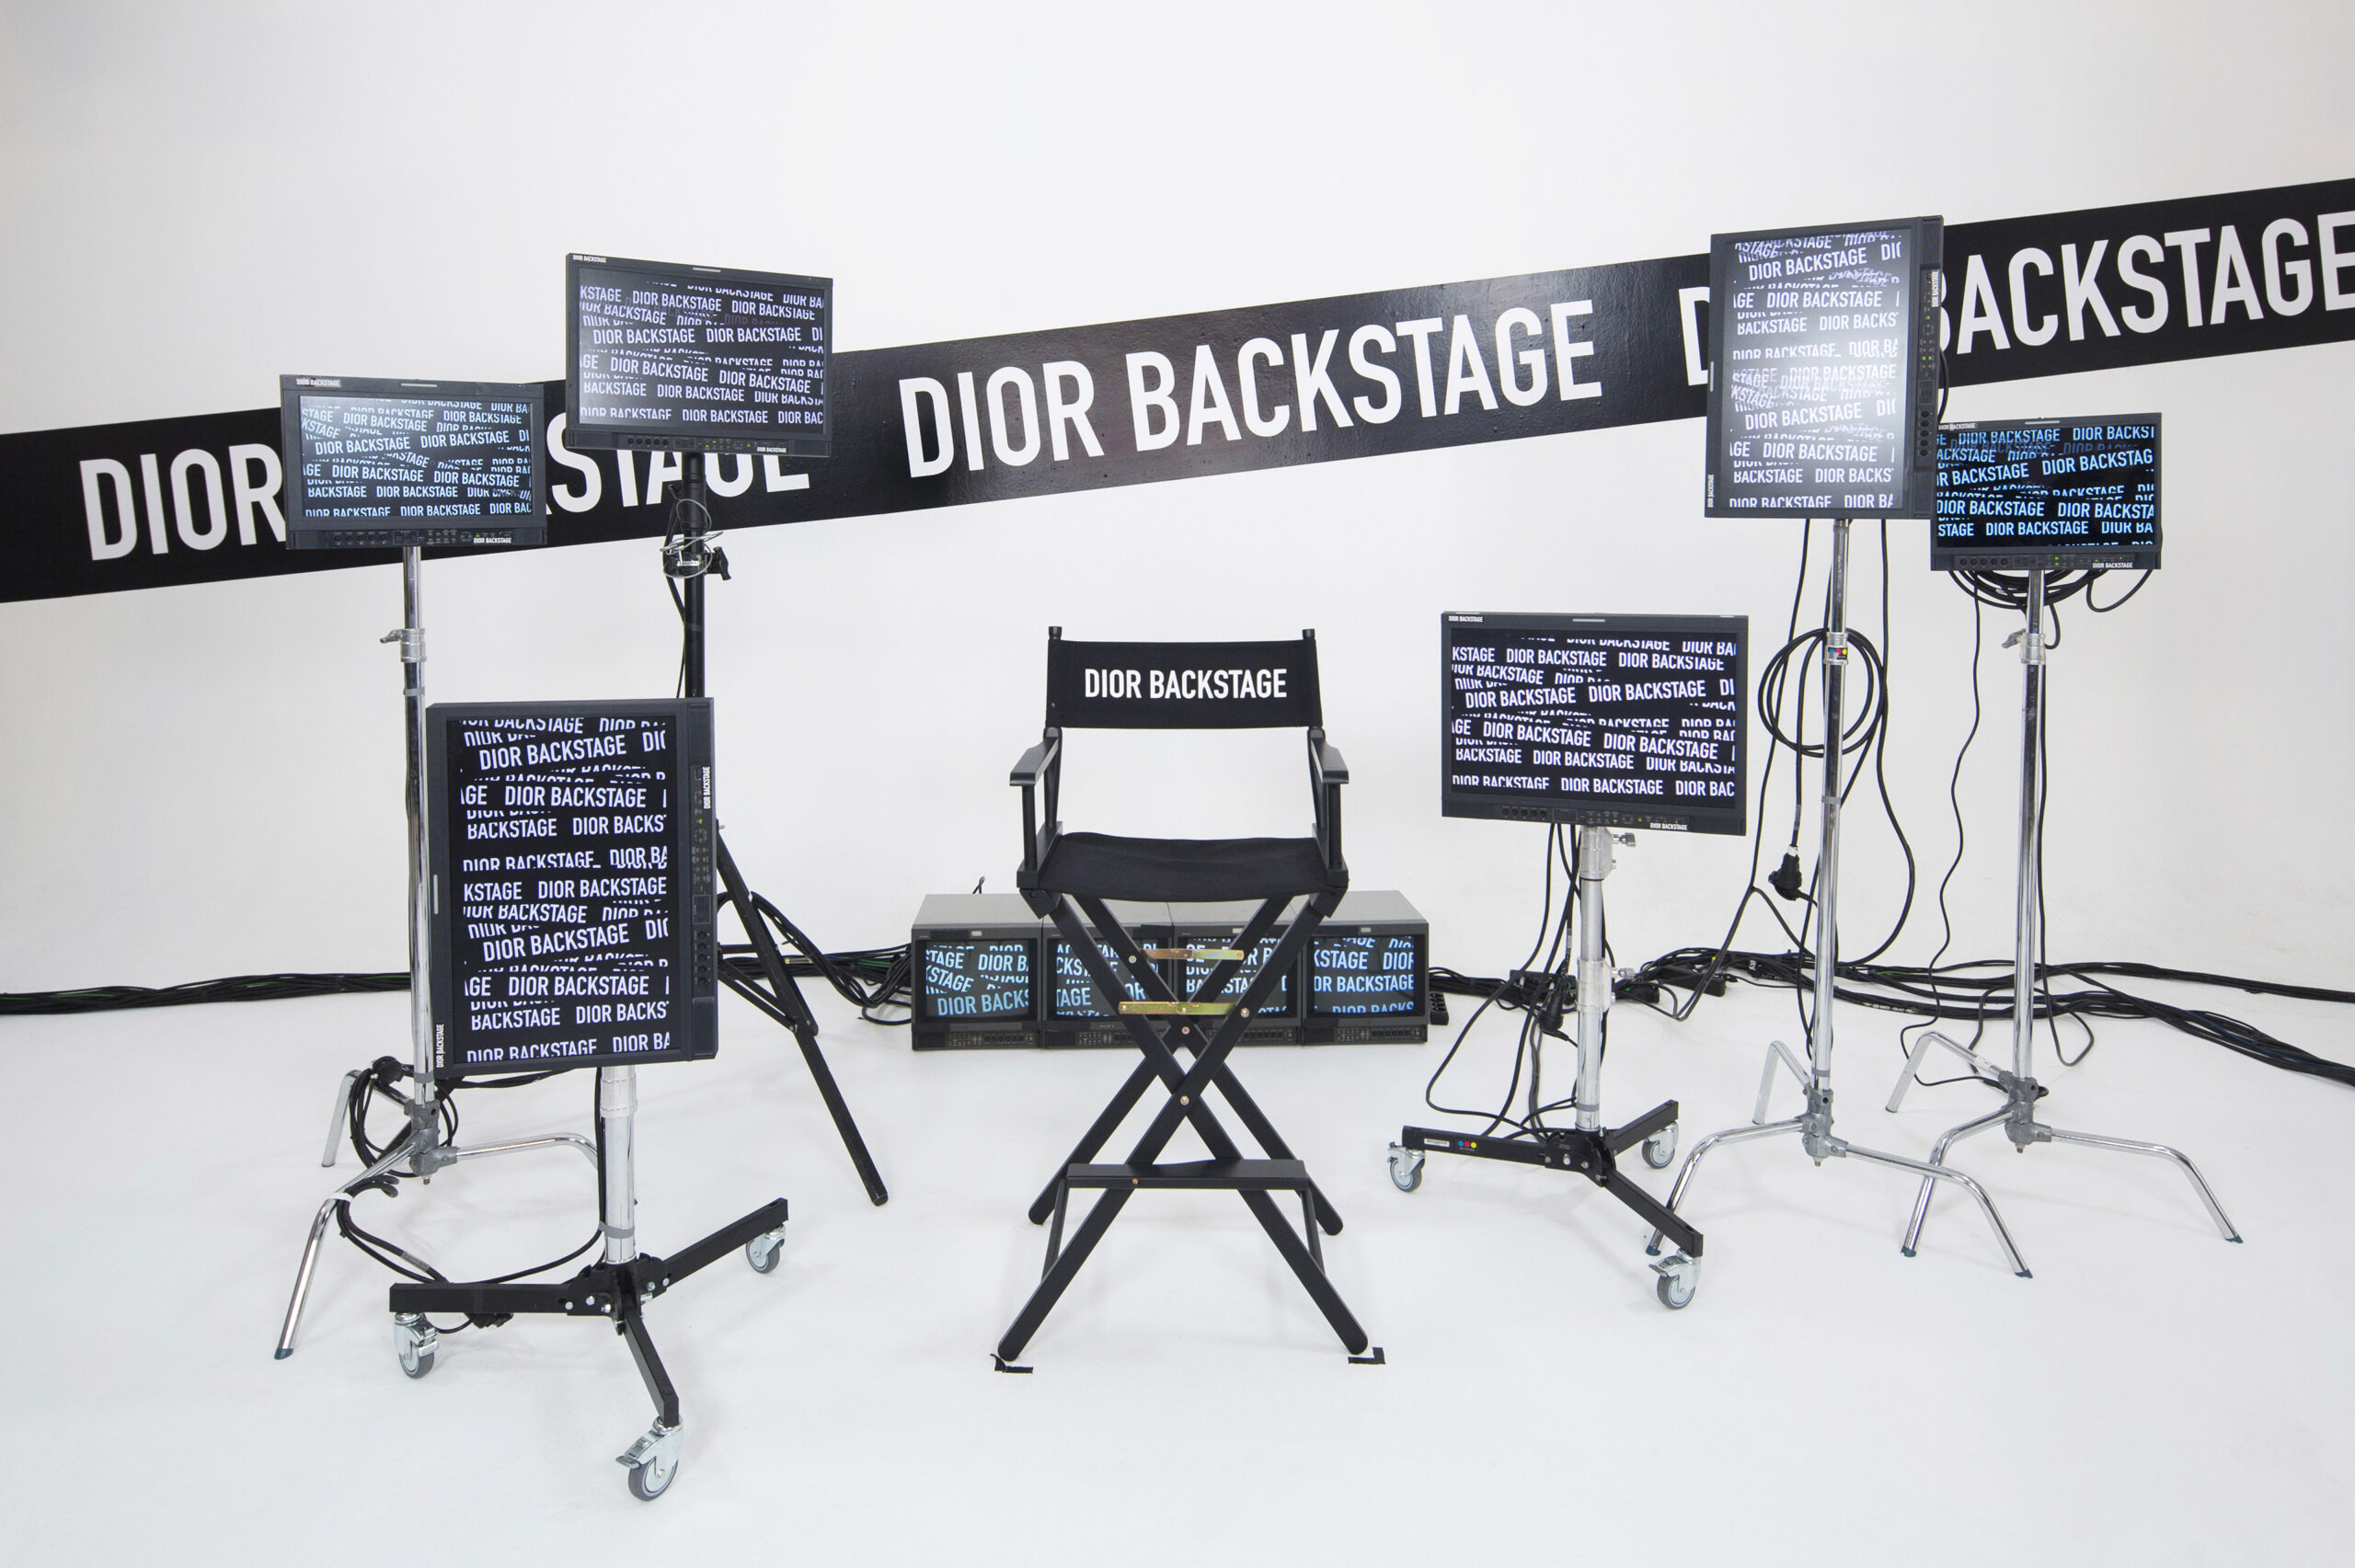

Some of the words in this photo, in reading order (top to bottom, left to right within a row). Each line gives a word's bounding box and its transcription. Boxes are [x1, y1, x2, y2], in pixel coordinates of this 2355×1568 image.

[1749, 262, 1783, 281] DIOR
[1786, 247, 1867, 276] BACKSTAGE
[632, 291, 659, 305] DIOR
[662, 293, 721, 312] BACKSTAGE
[731, 300, 756, 315] DIOR
[1766, 292, 1799, 308] DIOR
[1802, 291, 1883, 308] BACKSTAGE
[593, 329, 623, 344] DIOR
[626, 328, 695, 344] BACKSTAGE
[706, 328, 734, 343] DIOR
[738, 326, 801, 342] BACKSTAGE
[1738, 317, 1808, 335] BACKSTAGE
[1820, 315, 1849, 331] DIOR
[296, 378, 309, 386] DIOR
[311, 379, 340, 387] BACKSTAGE
[611, 357, 638, 374] DIOR
[642, 361, 708, 382] BACKSTAGE
[719, 370, 746, 386] DIOR
[749, 373, 811, 394] BACKSTAGE
[584, 382, 647, 396] BACKSTAGE
[657, 384, 682, 398] DIOR
[685, 385, 744, 402] BACKSTAGE
[899, 359, 1104, 478] DIOR
[1125, 299, 1603, 452] BACKSTAGE
[343, 413, 368, 426] DIOR
[371, 416, 428, 431] BACKSTAGE
[443, 410, 466, 422] DIOR
[683, 409, 707, 422] DIOR
[710, 409, 768, 424] BACKSTAGE
[777, 411, 801, 424] DIOR
[1745, 414, 1778, 430] DIOR
[1782, 402, 1862, 427] BACKSTAGE
[316, 441, 343, 455] DIOR
[346, 437, 410, 453] BACKSTAGE
[420, 435, 447, 448] DIOR
[449, 430, 510, 446] BACKSTAGE
[1959, 431, 1987, 444] DIOR
[1991, 429, 2061, 443] BACKSTAGE
[2073, 427, 2103, 441] DIOR
[1763, 442, 1794, 459] DIOR
[1798, 443, 1878, 463] BACKSTAGE
[332, 465, 359, 478] DIOR
[362, 467, 423, 482] BACKSTAGE
[434, 471, 458, 484] DIOR
[462, 473, 520, 487] BACKSTAGE
[1734, 468, 1803, 484] BACKSTAGE
[1815, 467, 1845, 484] DIOR
[1952, 463, 2029, 486] BACKSTAGE
[2042, 457, 2076, 475] DIOR
[79, 443, 286, 561] DIOR
[308, 486, 366, 498] BACKSTAGE
[376, 486, 399, 498] DIOR
[403, 486, 458, 498] BACKSTAGE
[1844, 494, 1875, 508] DIOR
[400, 505, 423, 516] DIOR
[427, 504, 481, 516] BACKSTAGE
[489, 503, 511, 514] DIOR
[1936, 500, 1966, 514] DIOR
[1970, 500, 2045, 517] BACKSTAGE
[2058, 502, 2090, 517] DIOR
[1938, 522, 1974, 537] STAGE
[1986, 522, 2015, 536] DIOR
[2018, 521, 2089, 535] BACKSTAGE
[1452, 647, 1496, 663] KSTAGE
[1506, 648, 1534, 664] DIOR
[1538, 649, 1607, 667] BACKSTAGE
[1619, 652, 1648, 669] DIOR
[1085, 669, 1142, 698] DIOR
[1149, 669, 1287, 699] BACKSTAGE
[1465, 692, 1497, 709] DIOR
[1500, 687, 1577, 707] BACKSTAGE
[1589, 685, 1622, 703] DIOR
[1625, 680, 1706, 701] BACKSTAGE
[1483, 721, 1514, 739] DIOR
[1517, 725, 1591, 747] BACKSTAGE
[1603, 733, 1636, 751] DIOR
[1639, 736, 1718, 760] BACKSTAGE
[479, 747, 523, 771] DIOR
[527, 735, 626, 765] BACKSTAGE
[1456, 749, 1522, 764] BACKSTAGE
[1533, 750, 1562, 766] DIOR
[1565, 750, 1635, 770] BACKSTAGE
[702, 766, 710, 795] BACKSTAGE
[1561, 777, 1590, 793] DIOR
[1593, 778, 1664, 795] BACKSTAGE
[1675, 780, 1706, 796] DIOR
[505, 786, 545, 807] DIOR
[551, 787, 647, 808] BACKSTAGE
[703, 795, 711, 809] DIOR
[467, 818, 557, 840] BACKSTAGE
[572, 816, 609, 836] DIOR
[464, 882, 523, 902] KSTAGE
[538, 880, 575, 899] DIOR
[580, 876, 667, 898] BACKSTAGE
[483, 938, 525, 962] DIOR
[530, 923, 629, 956] BACKSTAGE
[978, 954, 1012, 972] DIOR
[509, 976, 548, 997] DIOR
[554, 976, 649, 996] BACKSTAGE
[937, 996, 977, 1016] DIOR
[471, 1008, 560, 1031] BACKSTAGE
[576, 1004, 612, 1024] DIOR
[436, 1024, 444, 1054] BACKSTAGE
[613, 1035, 649, 1053] DIOR
[436, 1054, 444, 1068] DIOR
